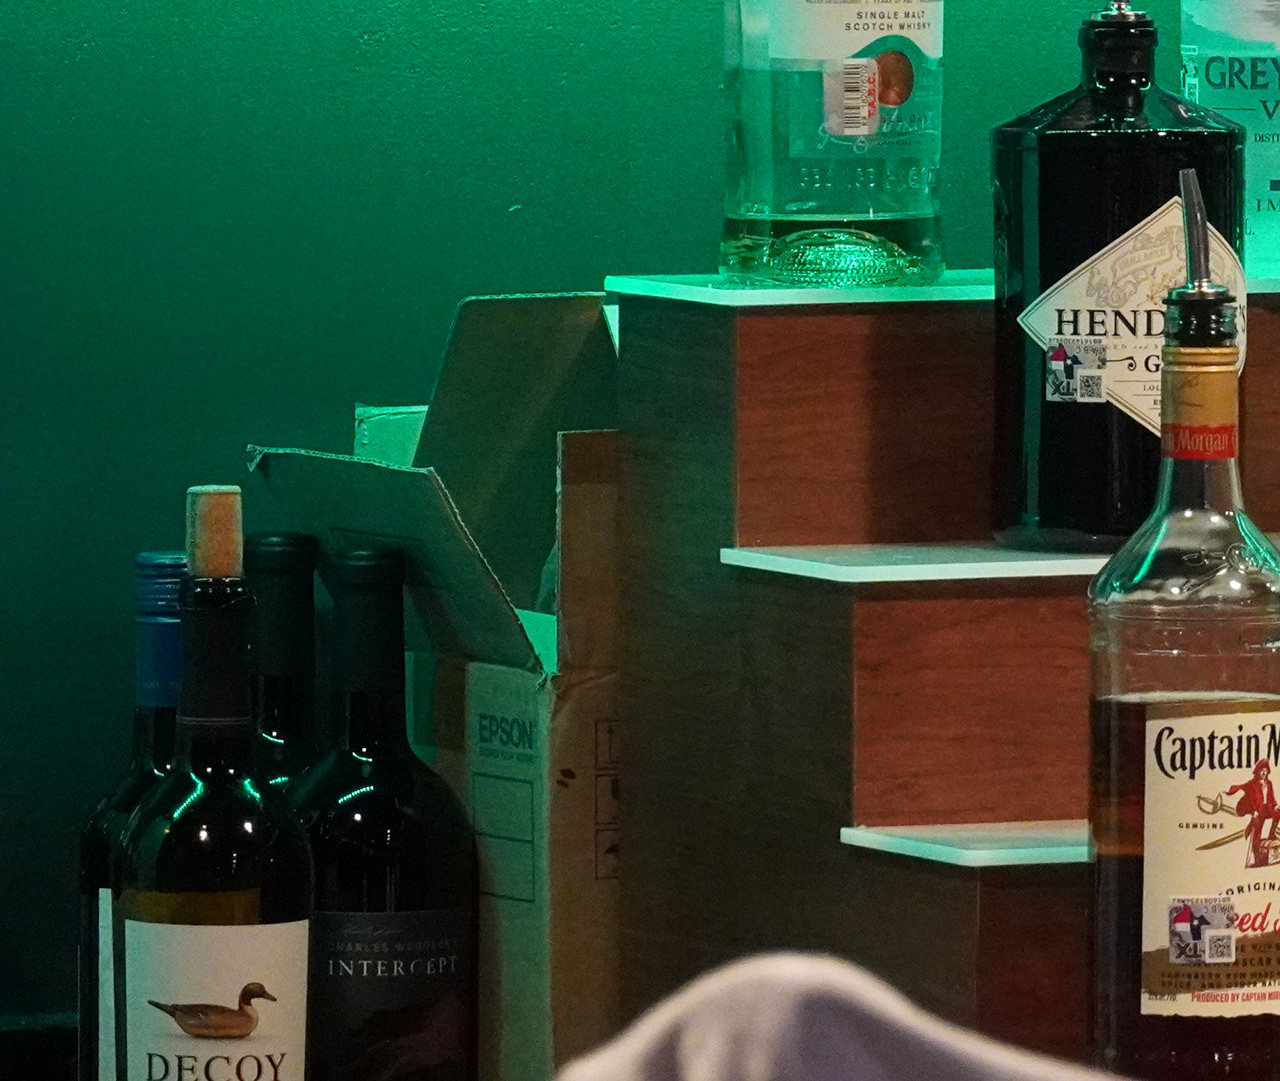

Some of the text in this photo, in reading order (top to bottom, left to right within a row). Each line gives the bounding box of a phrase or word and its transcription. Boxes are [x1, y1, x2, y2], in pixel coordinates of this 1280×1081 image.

[856, 10, 926, 20] SINGLE MALT
[844, 22, 932, 32] SCOTCH WHISKY
[1054, 308, 1166, 337] HEND
[1177, 429, 1230, 454] Morgan
[477, 713, 534, 750] EPSON
[1153, 723, 1260, 780] Captain
[1178, 822, 1225, 830] GENUINE
[328, 955, 458, 977] INTERCEPT
[1191, 992, 1229, 1002] PRODUCED
[1231, 992, 1240, 1001] BY
[1241, 991, 1267, 1001] CAPTAIN
[146, 1051, 288, 1081] DECOY
